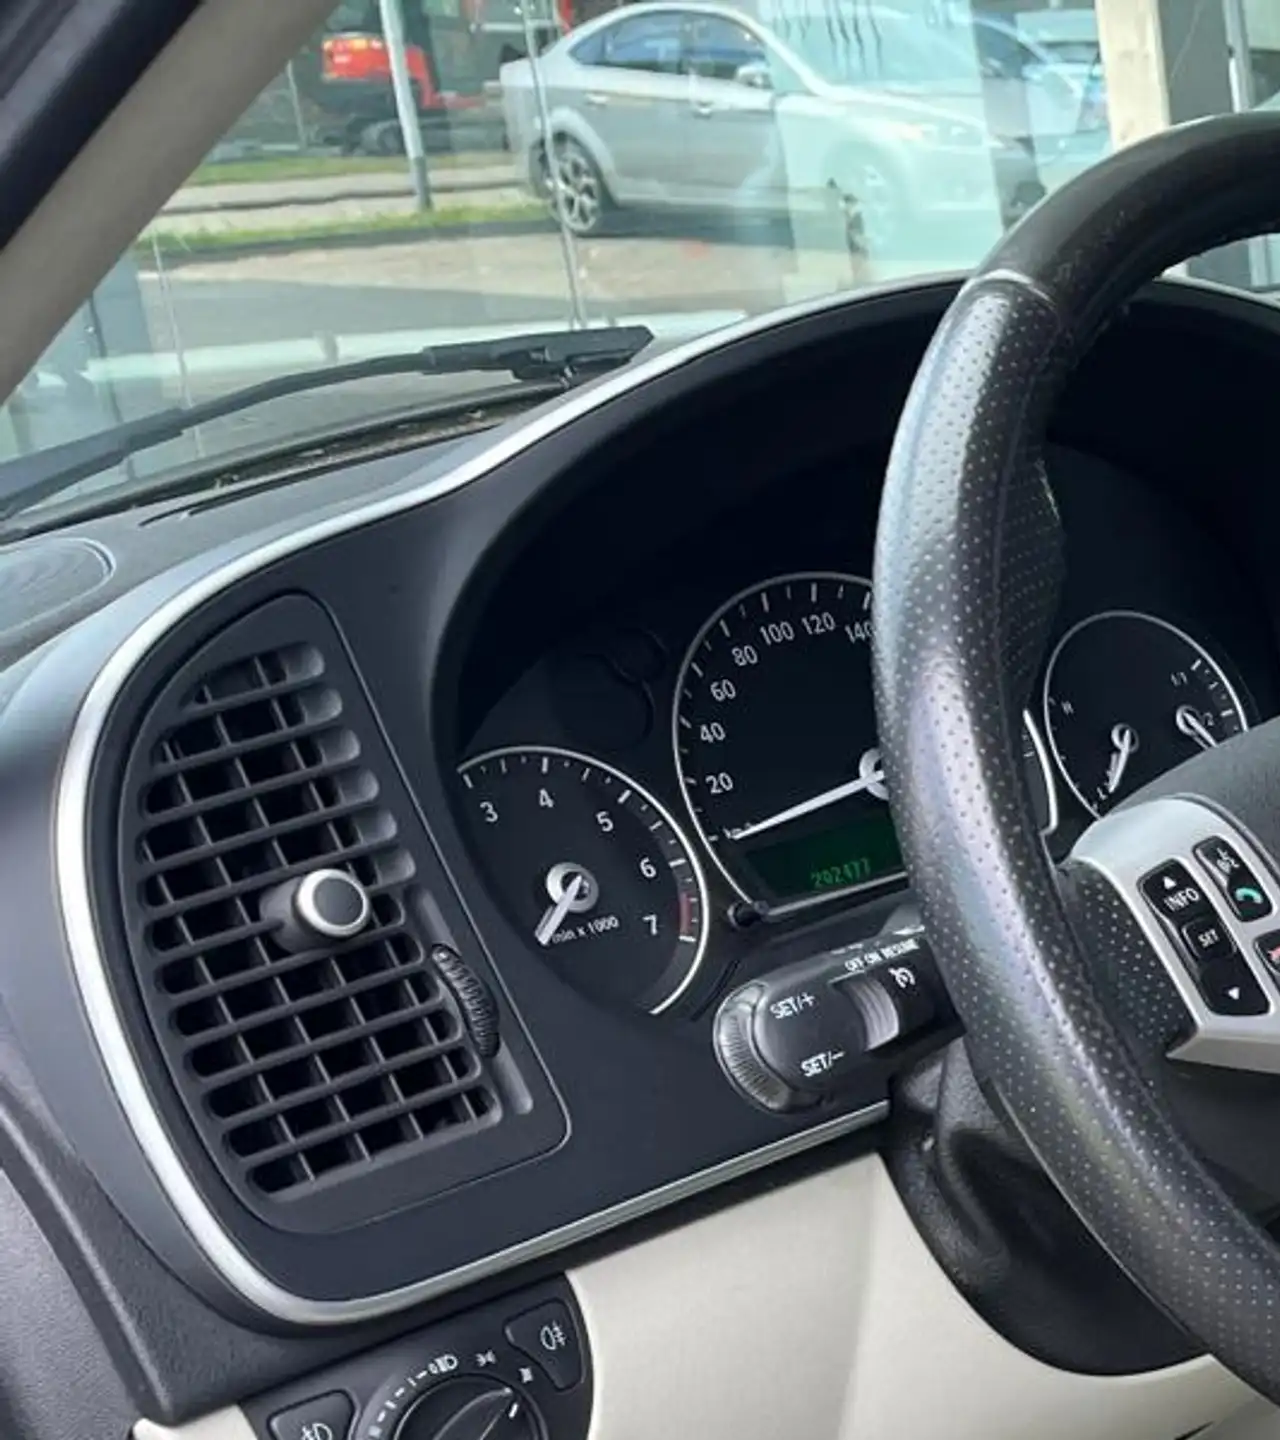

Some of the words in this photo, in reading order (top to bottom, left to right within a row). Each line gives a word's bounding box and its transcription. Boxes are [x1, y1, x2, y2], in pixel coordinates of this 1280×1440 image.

[760, 621, 795, 646] 100
[801, 611, 836, 635] 120
[731, 645, 758, 667] 80
[710, 679, 736, 702] 60
[700, 722, 726, 743] 40
[705, 772, 734, 794] 20
[539, 788, 554, 808] 4
[480, 801, 498, 823] 3
[595, 811, 614, 832] 5
[640, 857, 657, 878] 6
[1163, 887, 1200, 912] INFO
[642, 914, 659, 935] 7
[1198, 928, 1221, 948] SET
[769, 991, 816, 1020] SET/+
